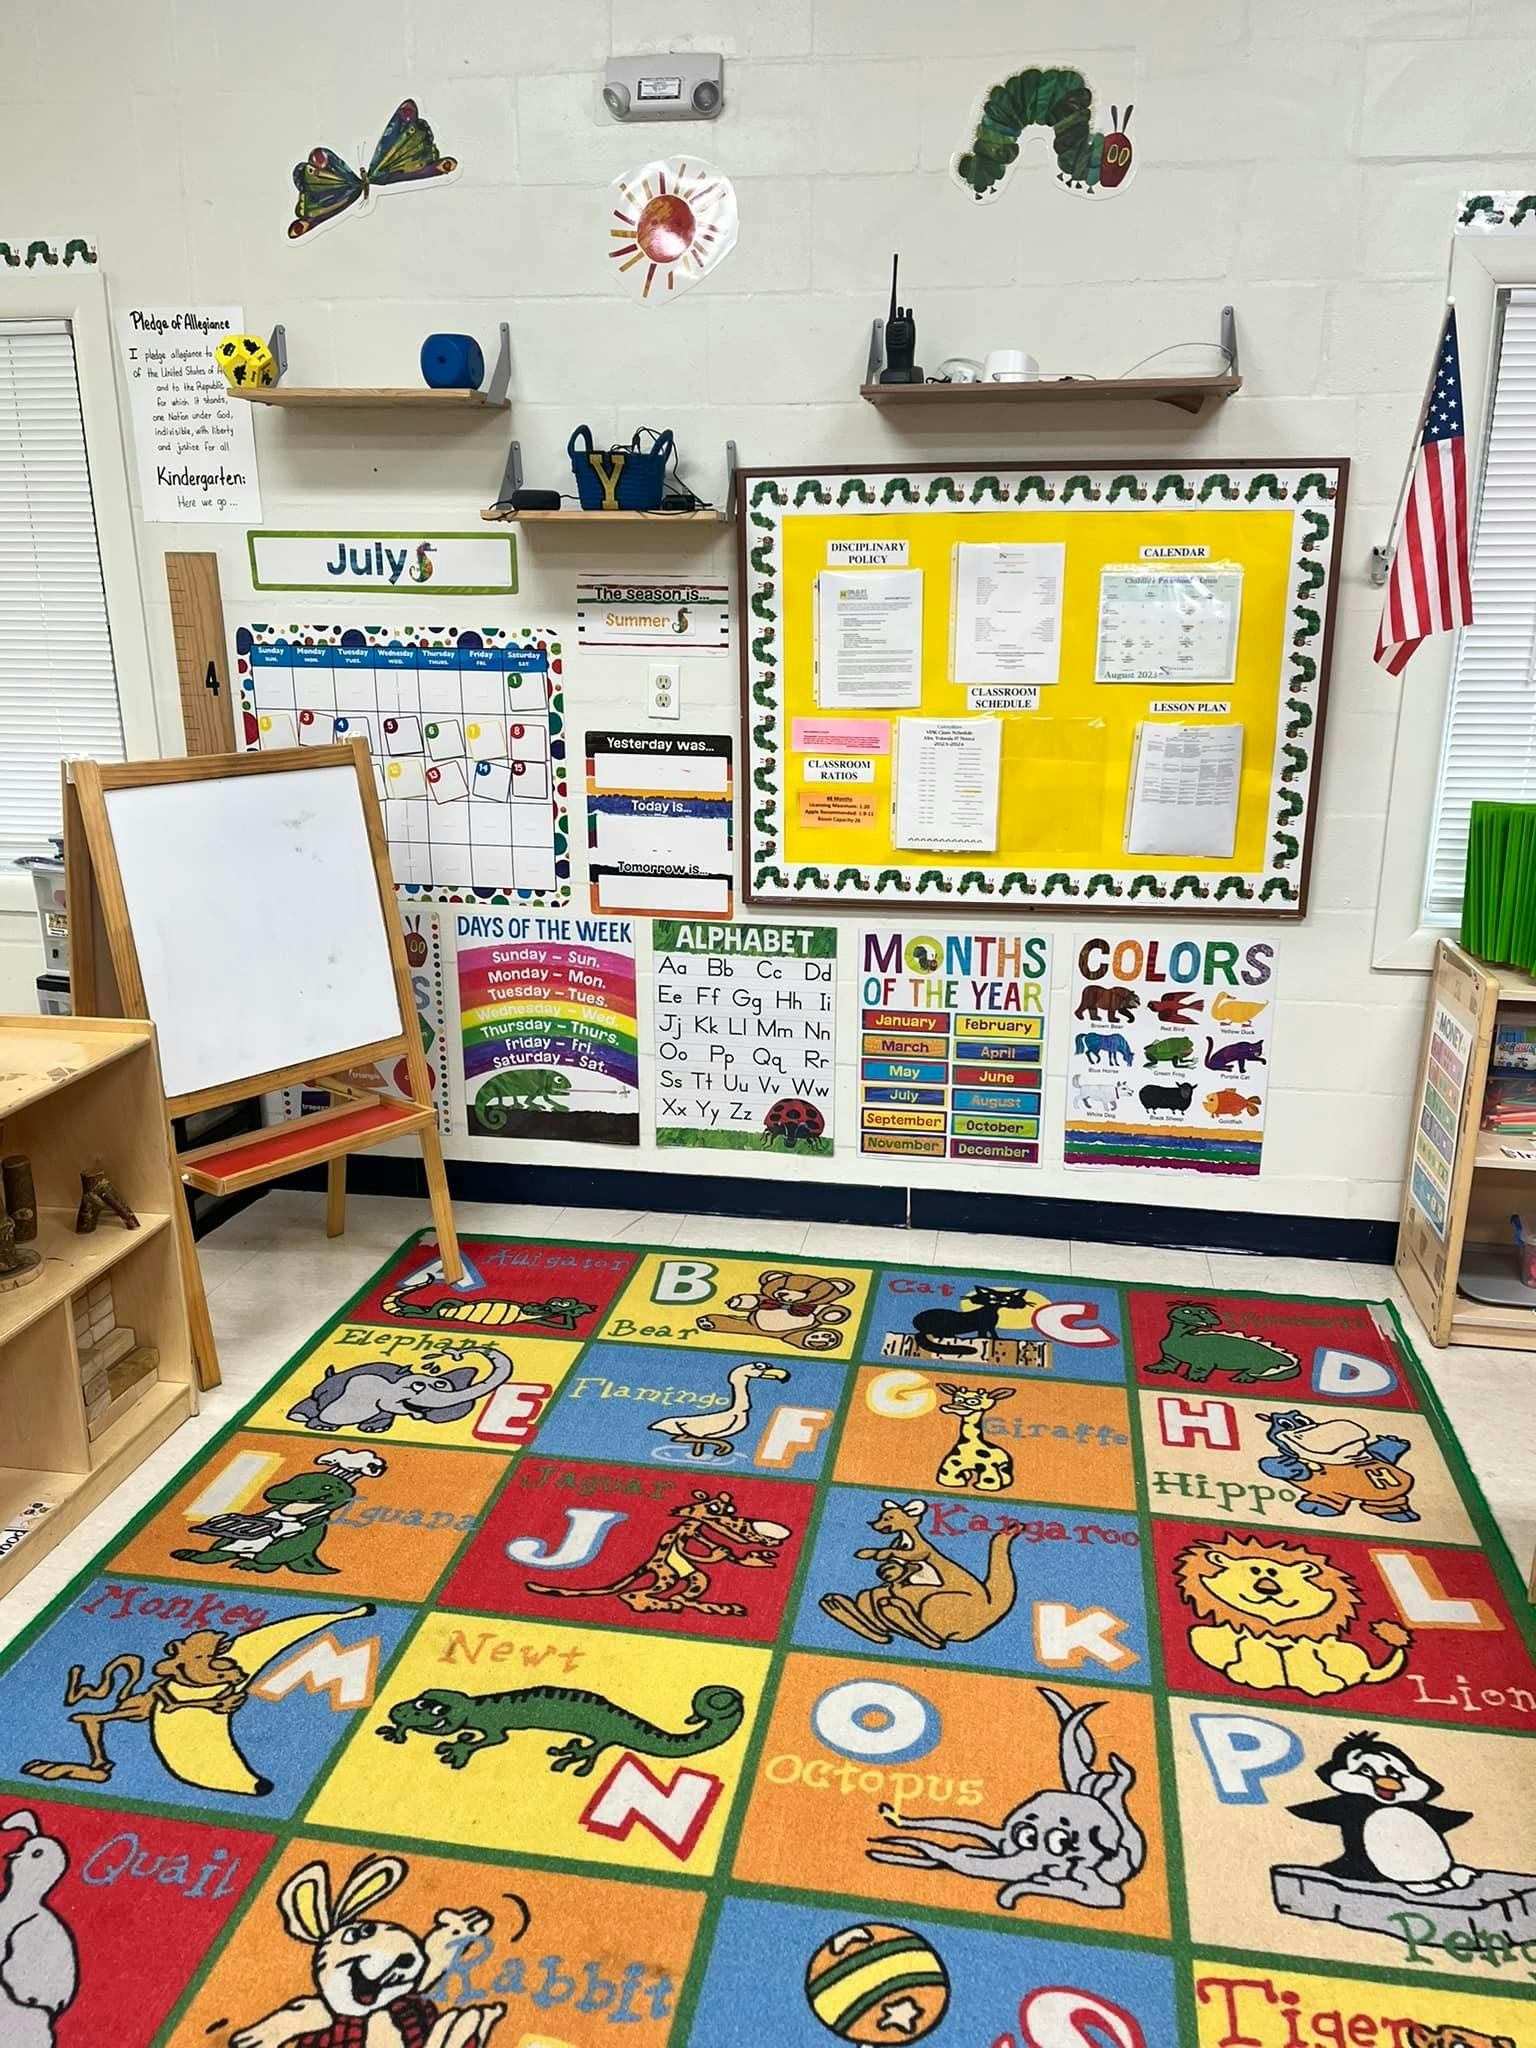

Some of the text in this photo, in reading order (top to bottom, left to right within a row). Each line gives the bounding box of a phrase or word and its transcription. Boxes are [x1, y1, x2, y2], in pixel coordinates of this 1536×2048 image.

[129, 310, 230, 336] Pledge of Allegiance
[128, 345, 213, 364] I pledge allegiance to
[152, 410, 234, 422] one Nation under God,
[156, 465, 247, 491] Kindergarten:
[589, 454, 625, 510] Y
[177, 495, 197, 508] Here
[201, 499, 213, 507] we
[830, 542, 906, 553] DISCIPLINARY
[848, 554, 888, 565] POLICY
[1144, 548, 1205, 558] CALENDAR
[326, 542, 407, 585] July
[594, 586, 710, 602] The season is...
[605, 613, 670, 629] Summer
[258, 647, 540, 660] Sunday Monday Tuesday Wednesday Thursday Friday Saturday
[205, 661, 220, 697] 4
[970, 687, 1037, 698] CLASSROOM
[975, 699, 1032, 709] SCHEDULE
[1153, 703, 1228, 712] LESSON PLAN
[606, 736, 715, 752] Yesterday was...
[428, 763, 523, 781] 13 14 15
[807, 759, 871, 770] CLASSROOM
[820, 771, 858, 781] RATIOS
[631, 800, 692, 814] Today is...
[617, 861, 709, 875] Tomorrow is...
[457, 916, 632, 943] DAYS OF THE WEEK
[675, 925, 814, 954] ALPHABET
[492, 949, 601, 968] Sunday Sun.
[658, 955, 832, 982] Aa Bb Cc Dd
[863, 933, 1047, 979] MONTHS
[1078, 938, 1274, 986] COLORS
[488, 967, 606, 989] Monday Mon.
[488, 985, 608, 1008] Tuesday Tues.
[658, 985, 831, 1016] Ee Ff Gg Hh Ii
[863, 977, 1044, 1013] OF THE YEAR
[476, 1002, 619, 1027] Wednesday Wed.
[659, 1014, 831, 1041] Jj Kk Ll Mm Nn
[875, 1014, 1032, 1035] January February
[480, 1018, 619, 1046] Thursday Thurs.
[1439, 1011, 1464, 1053] MONEY
[505, 1036, 594, 1056] Friday Fri.
[881, 1040, 1016, 1060] March April
[493, 1051, 608, 1073] Saturday Sat.
[889, 1065, 1015, 1083] May June
[662, 1097, 753, 1126] Xx Yy Zz
[890, 1089, 1021, 1109] July August
[866, 1113, 1024, 1134] September October
[867, 1137, 1030, 1158] November December
[650, 1261, 719, 1305] B
[888, 1278, 956, 1299] Cat
[608, 1319, 700, 1340] Bear
[1030, 1301, 1119, 1349] C
[341, 1328, 500, 1355] Elephant
[1311, 1347, 1398, 1397] D
[568, 1378, 731, 1408] Flamingo
[865, 1369, 937, 1419] G
[472, 1382, 552, 1444] E
[1157, 1397, 1241, 1450] H
[753, 1406, 832, 1468] F
[982, 1417, 1130, 1446] Giraffe
[520, 1465, 680, 1500] Jaguar
[1151, 1471, 1301, 1513] Hippo
[327, 1498, 480, 1534] Iguana
[928, 1502, 1139, 1547] Kangaroo
[0, 1529, 29, 1555] ood
[505, 1506, 628, 1572] J
[1372, 1550, 1505, 1631] L
[81, 1584, 269, 1629] Monkey
[1033, 1602, 1139, 1673] K
[440, 1631, 589, 1673] Newt
[253, 1634, 380, 1712] M
[1406, 1674, 1536, 1713] Lion
[810, 1678, 941, 1764] O
[1190, 1712, 1305, 1805] P
[764, 1755, 986, 1822] Octopus
[580, 1752, 724, 1862] N
[81, 1832, 245, 1901] Quail
[430, 1935, 675, 2025] Rabbit
[1197, 1978, 1425, 2048] Tiger
